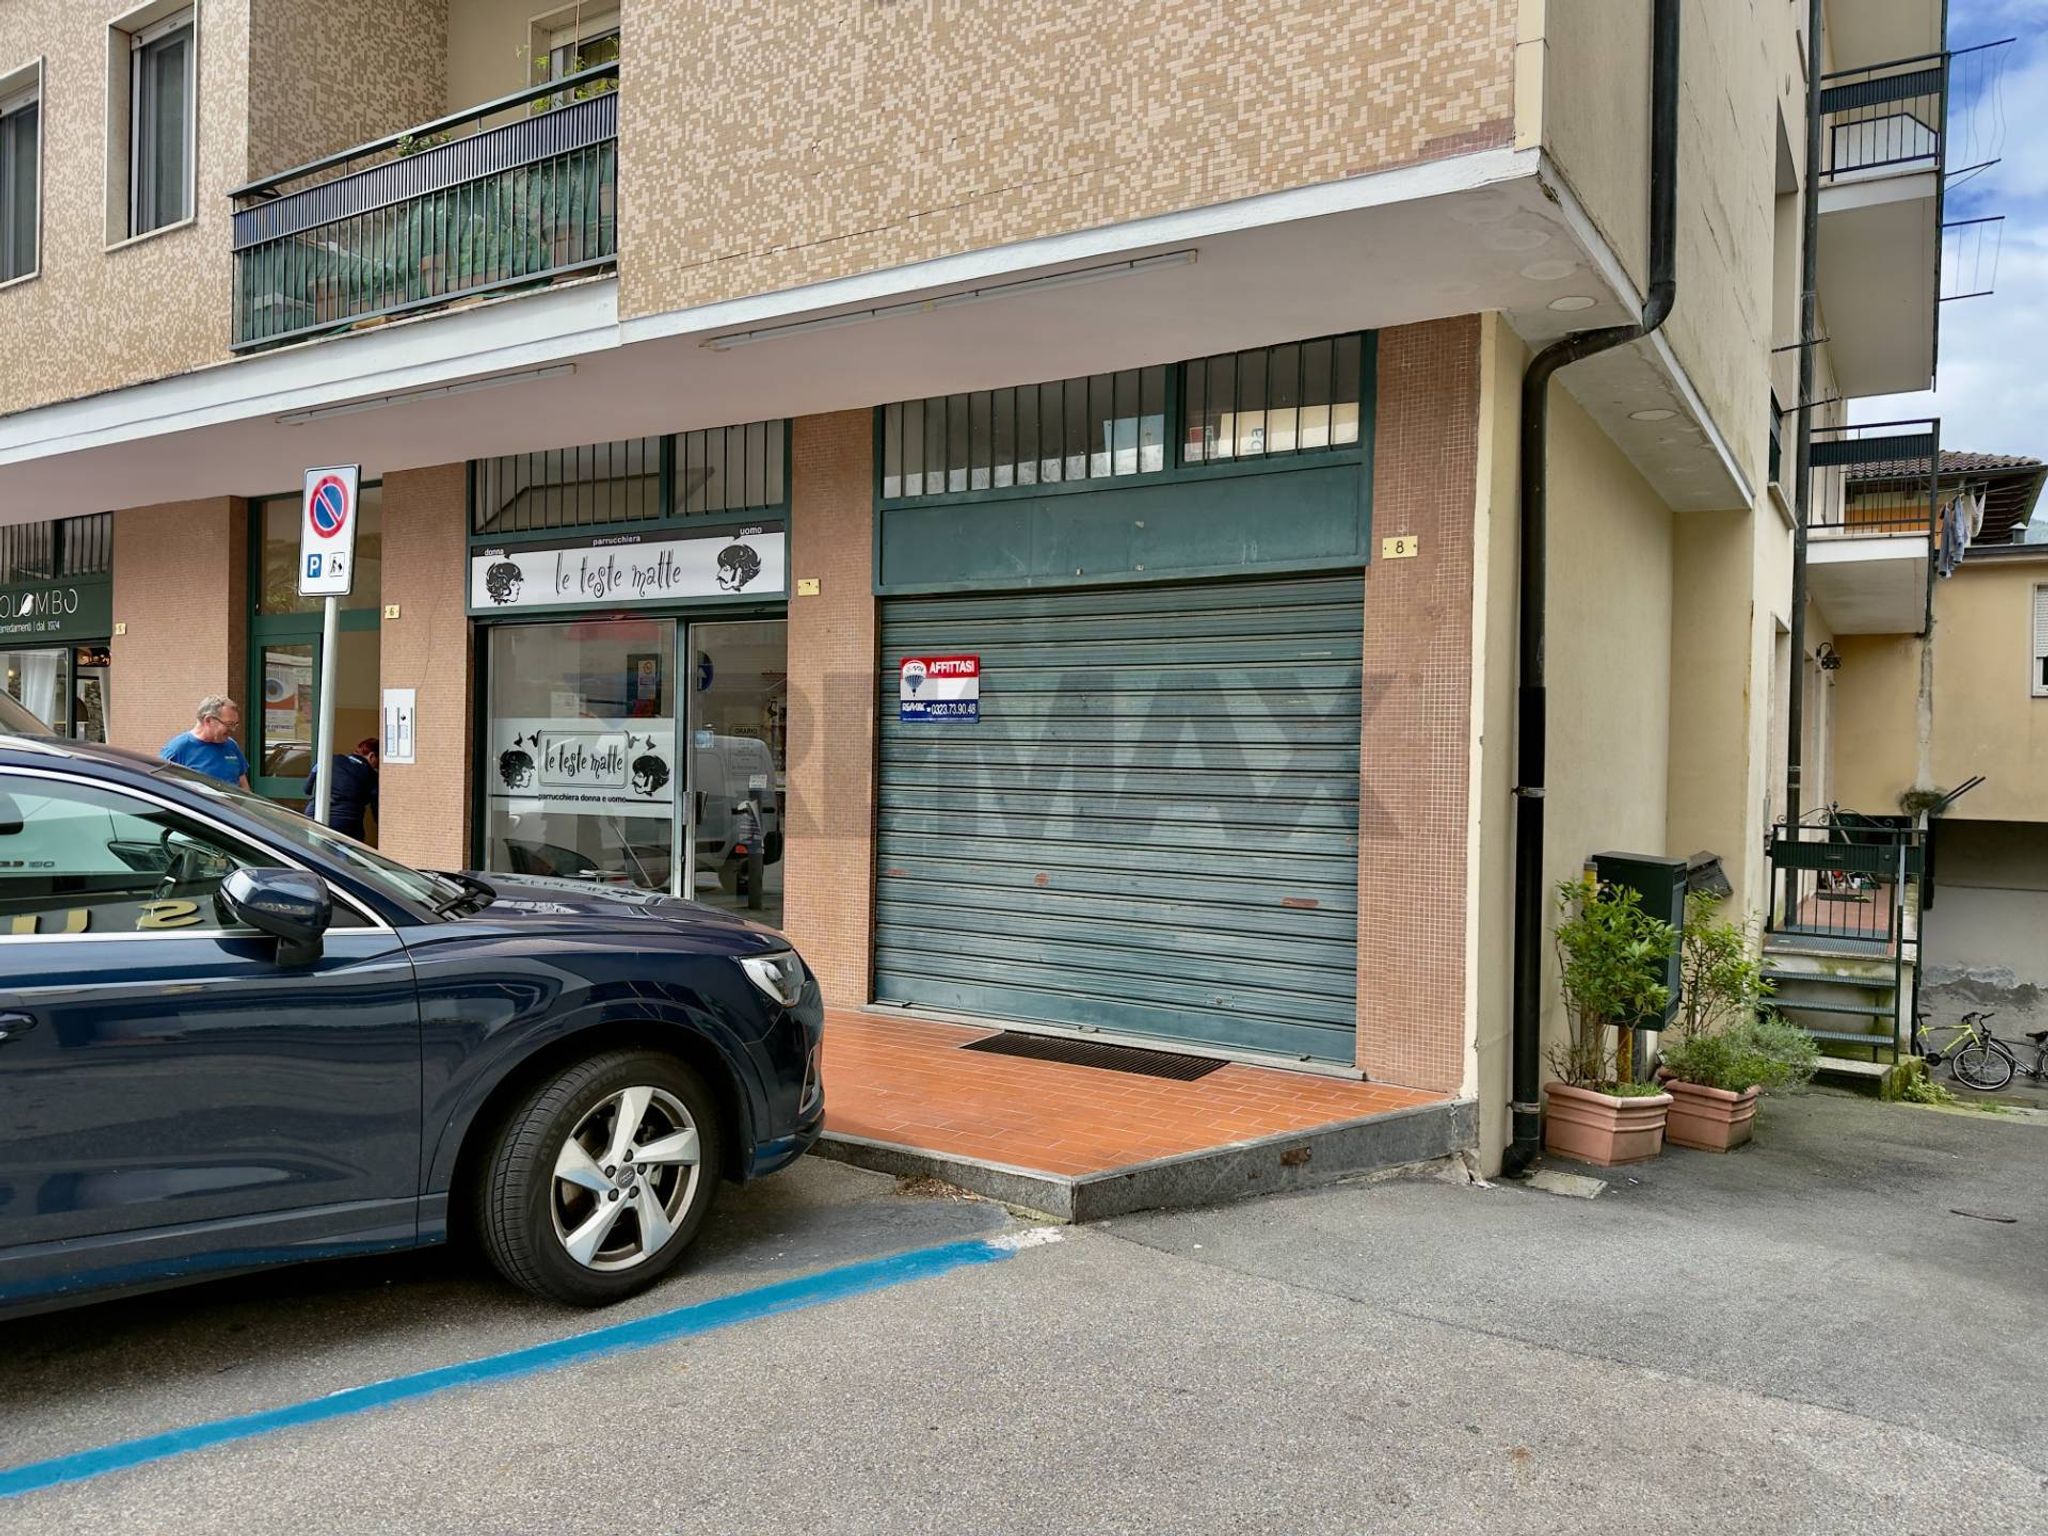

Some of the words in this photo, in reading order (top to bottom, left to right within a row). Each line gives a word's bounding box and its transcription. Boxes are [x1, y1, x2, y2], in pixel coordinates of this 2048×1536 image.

[739, 526, 763, 536] uomo
[592, 534, 641, 547] parrucchiera
[1395, 540, 1404, 554] 8
[484, 547, 505, 556] donna
[309, 556, 320, 576] P
[580, 552, 623, 598] teste
[631, 547, 682, 598] matte
[929, 660, 975, 674] AFFITTASI
[559, 743, 587, 777] teste
[590, 744, 623, 780] matte
[538, 793, 579, 802] parrucchiera
[580, 794, 601, 802] donna
